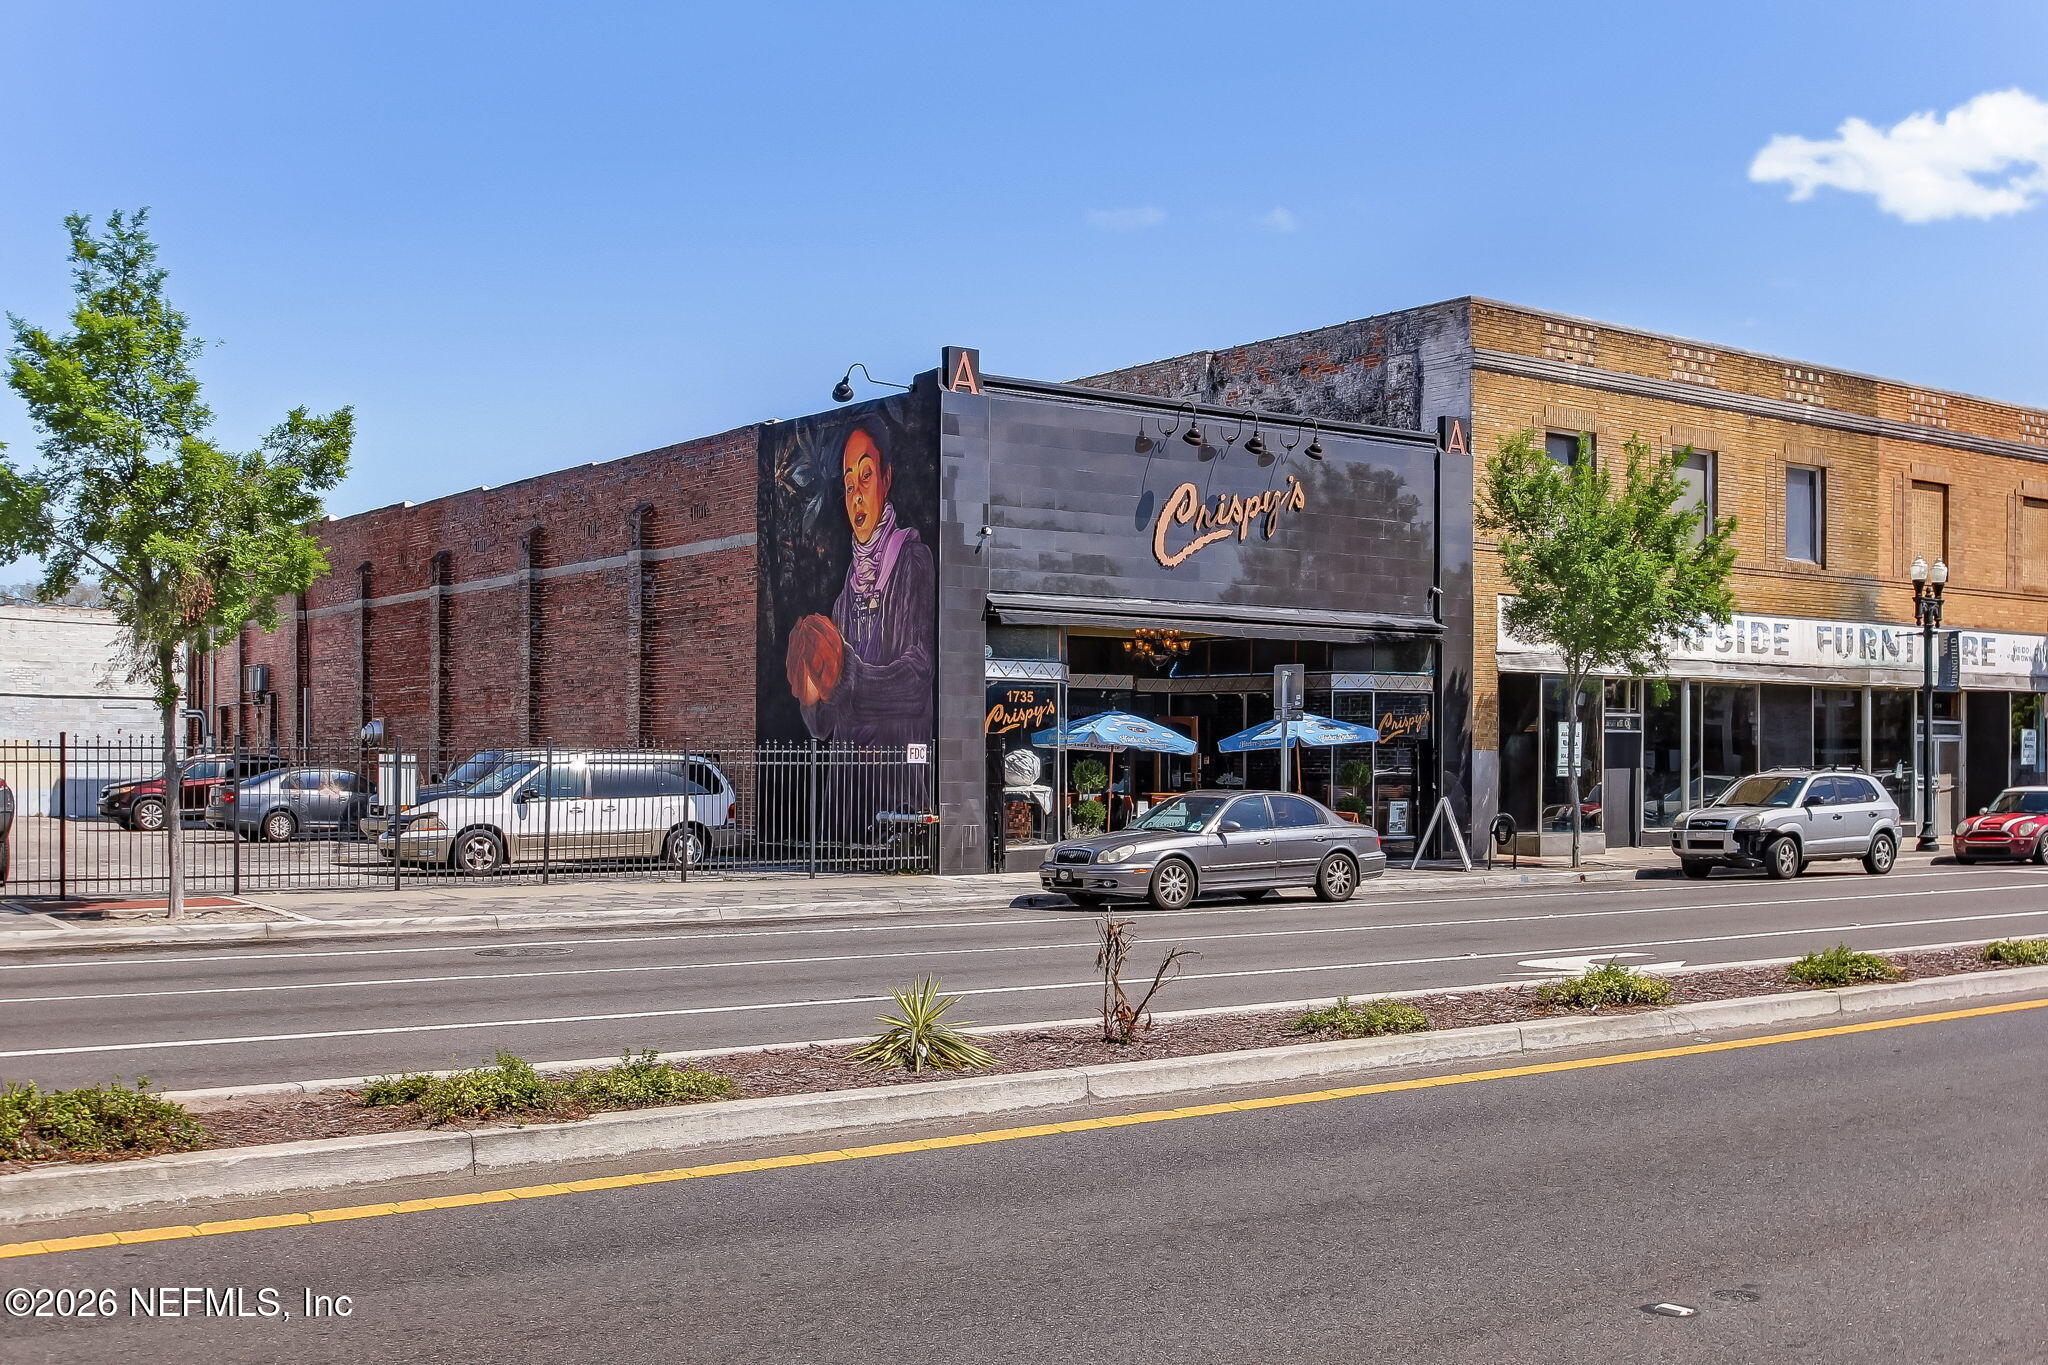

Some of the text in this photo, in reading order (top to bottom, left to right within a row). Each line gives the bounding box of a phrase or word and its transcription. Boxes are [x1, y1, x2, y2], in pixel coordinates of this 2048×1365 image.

[950, 351, 979, 395] A
[1447, 420, 1467, 455] A
[1154, 475, 1305, 568] Crispy's
[1816, 625, 1997, 667] FURNIRE
[1950, 637, 1958, 687] SPRINGFIELD
[1006, 690, 1035, 703] 1735
[985, 699, 1056, 734] Crispy's
[1378, 707, 1431, 744] Crispy's
[909, 747, 926, 760] FDC
